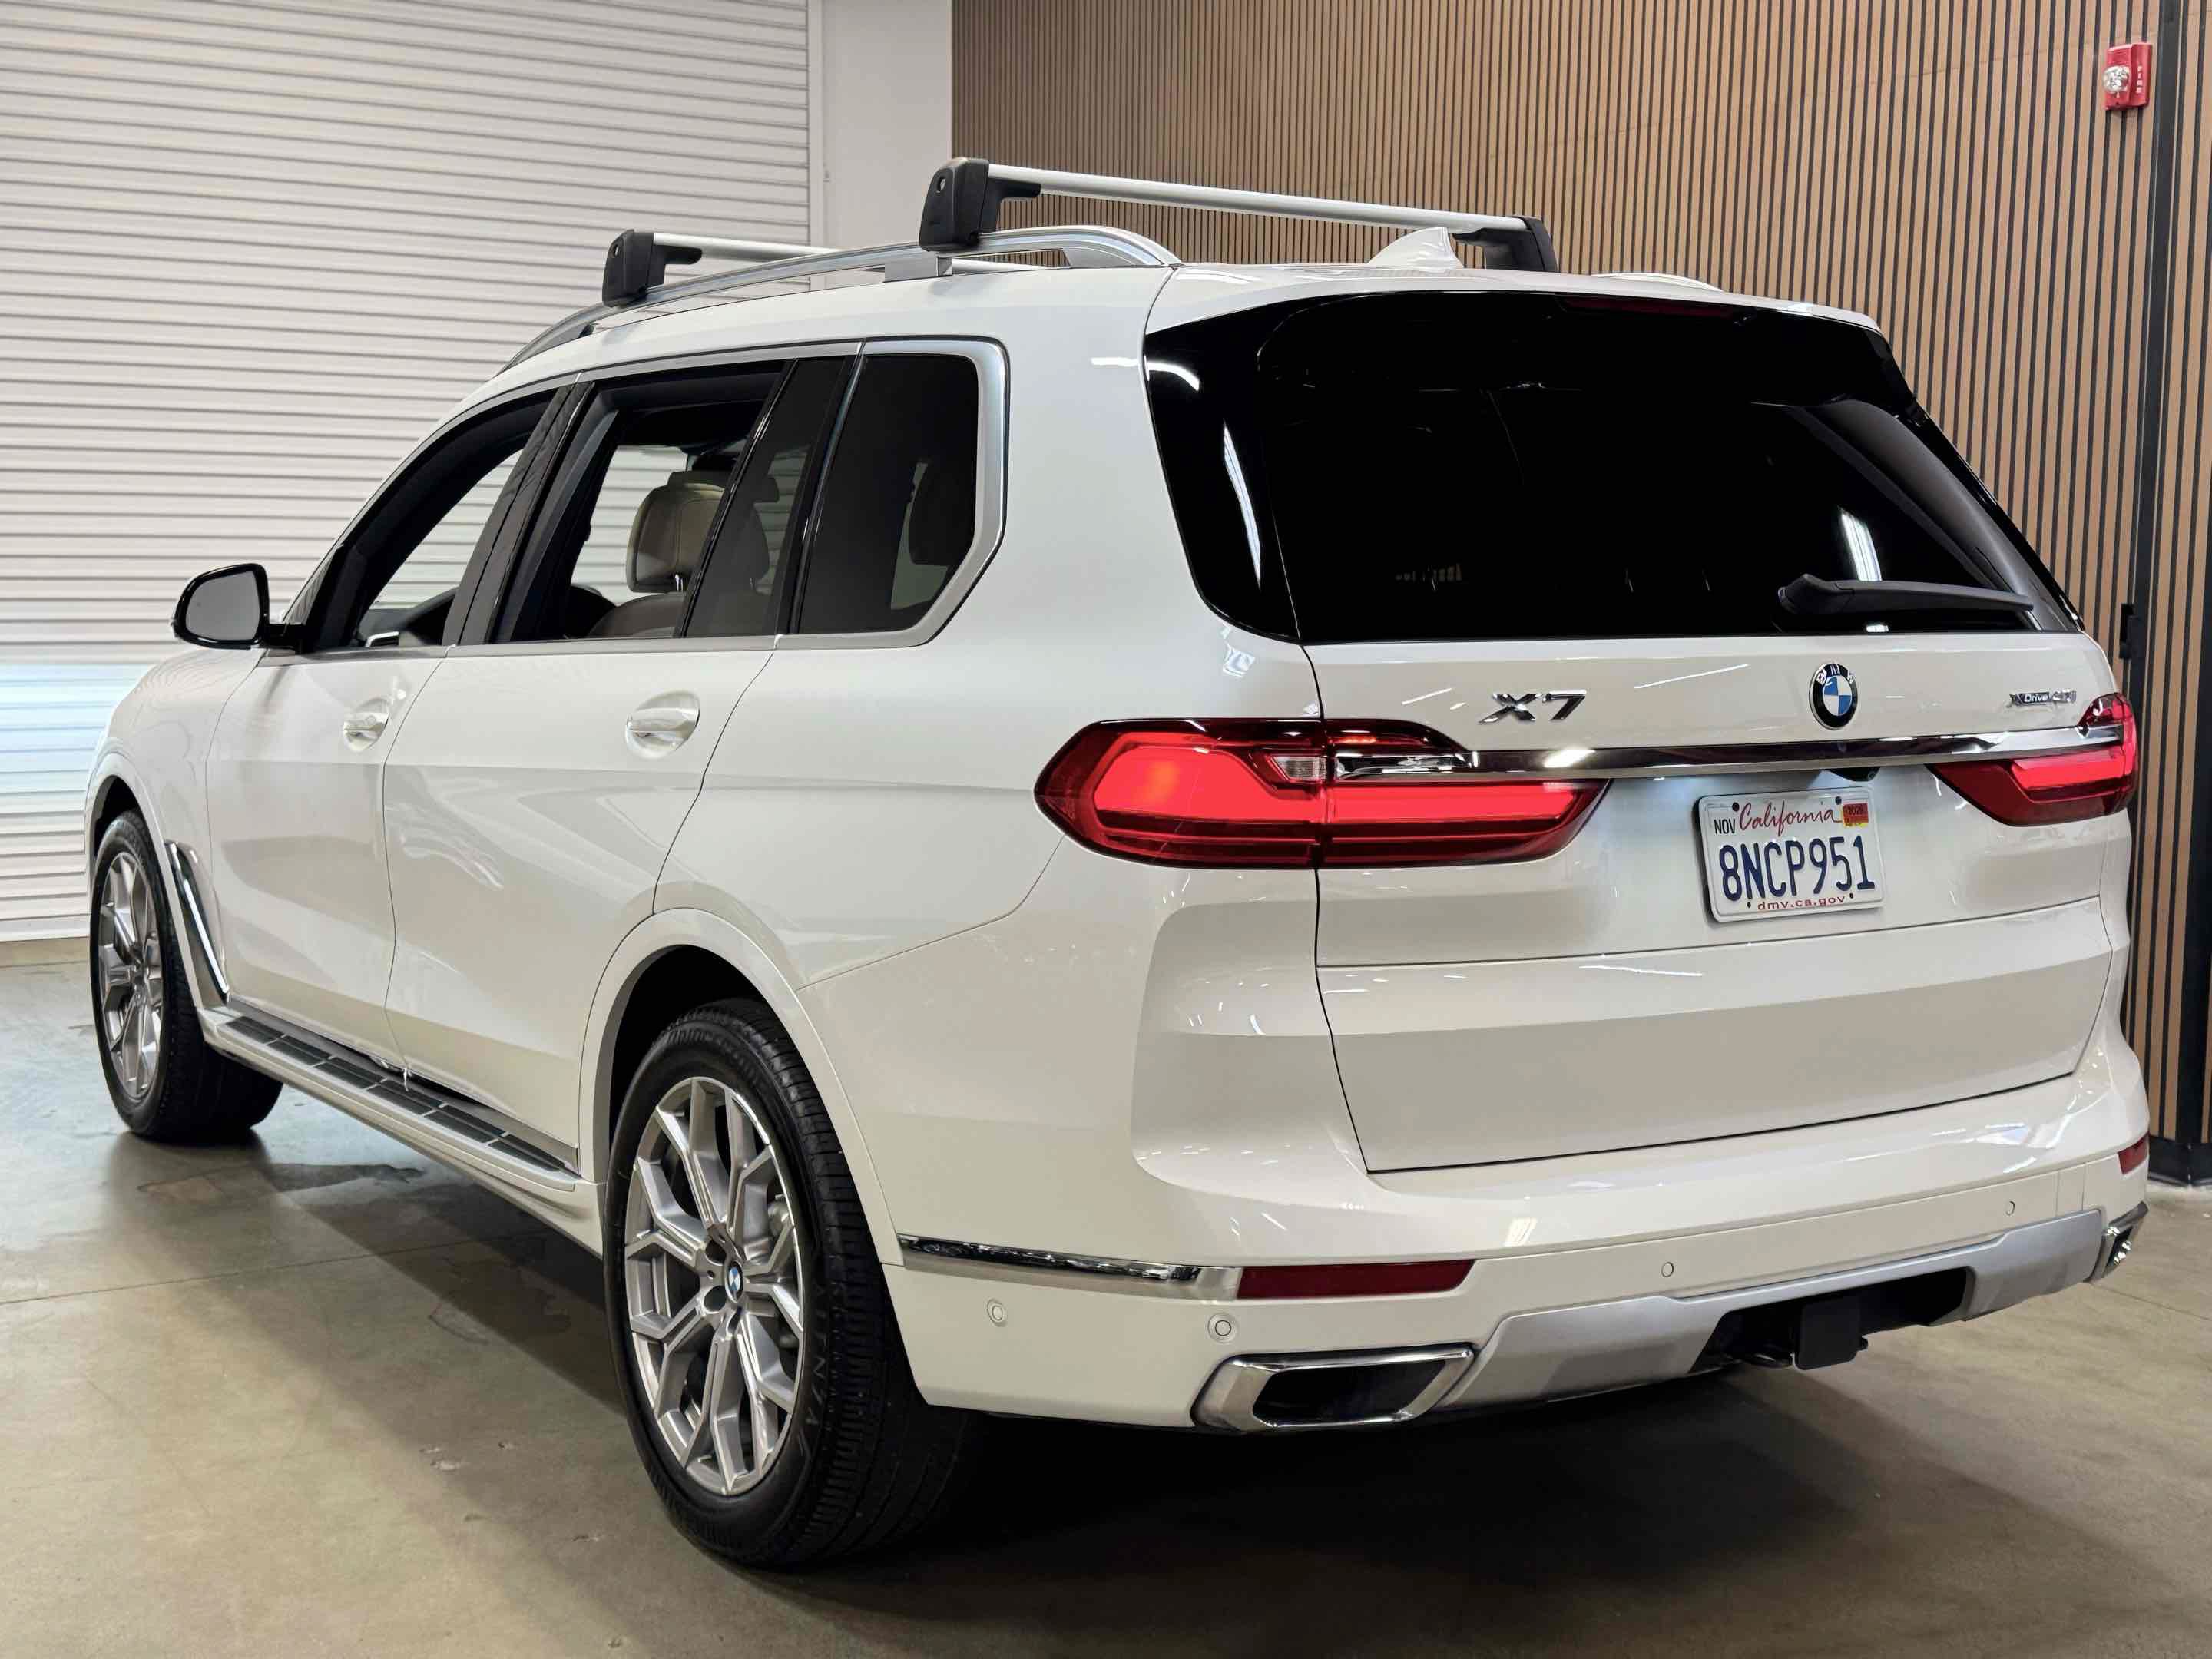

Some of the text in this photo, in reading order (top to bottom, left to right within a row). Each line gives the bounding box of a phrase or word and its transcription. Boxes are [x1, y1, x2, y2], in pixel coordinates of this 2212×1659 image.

[1479, 690, 1587, 723] X7
[1714, 819, 1736, 834] NOV
[1739, 800, 1843, 836] California
[1719, 836, 1875, 901] 8NCP951
[1757, 896, 1845, 910] dmv.ca.gov
